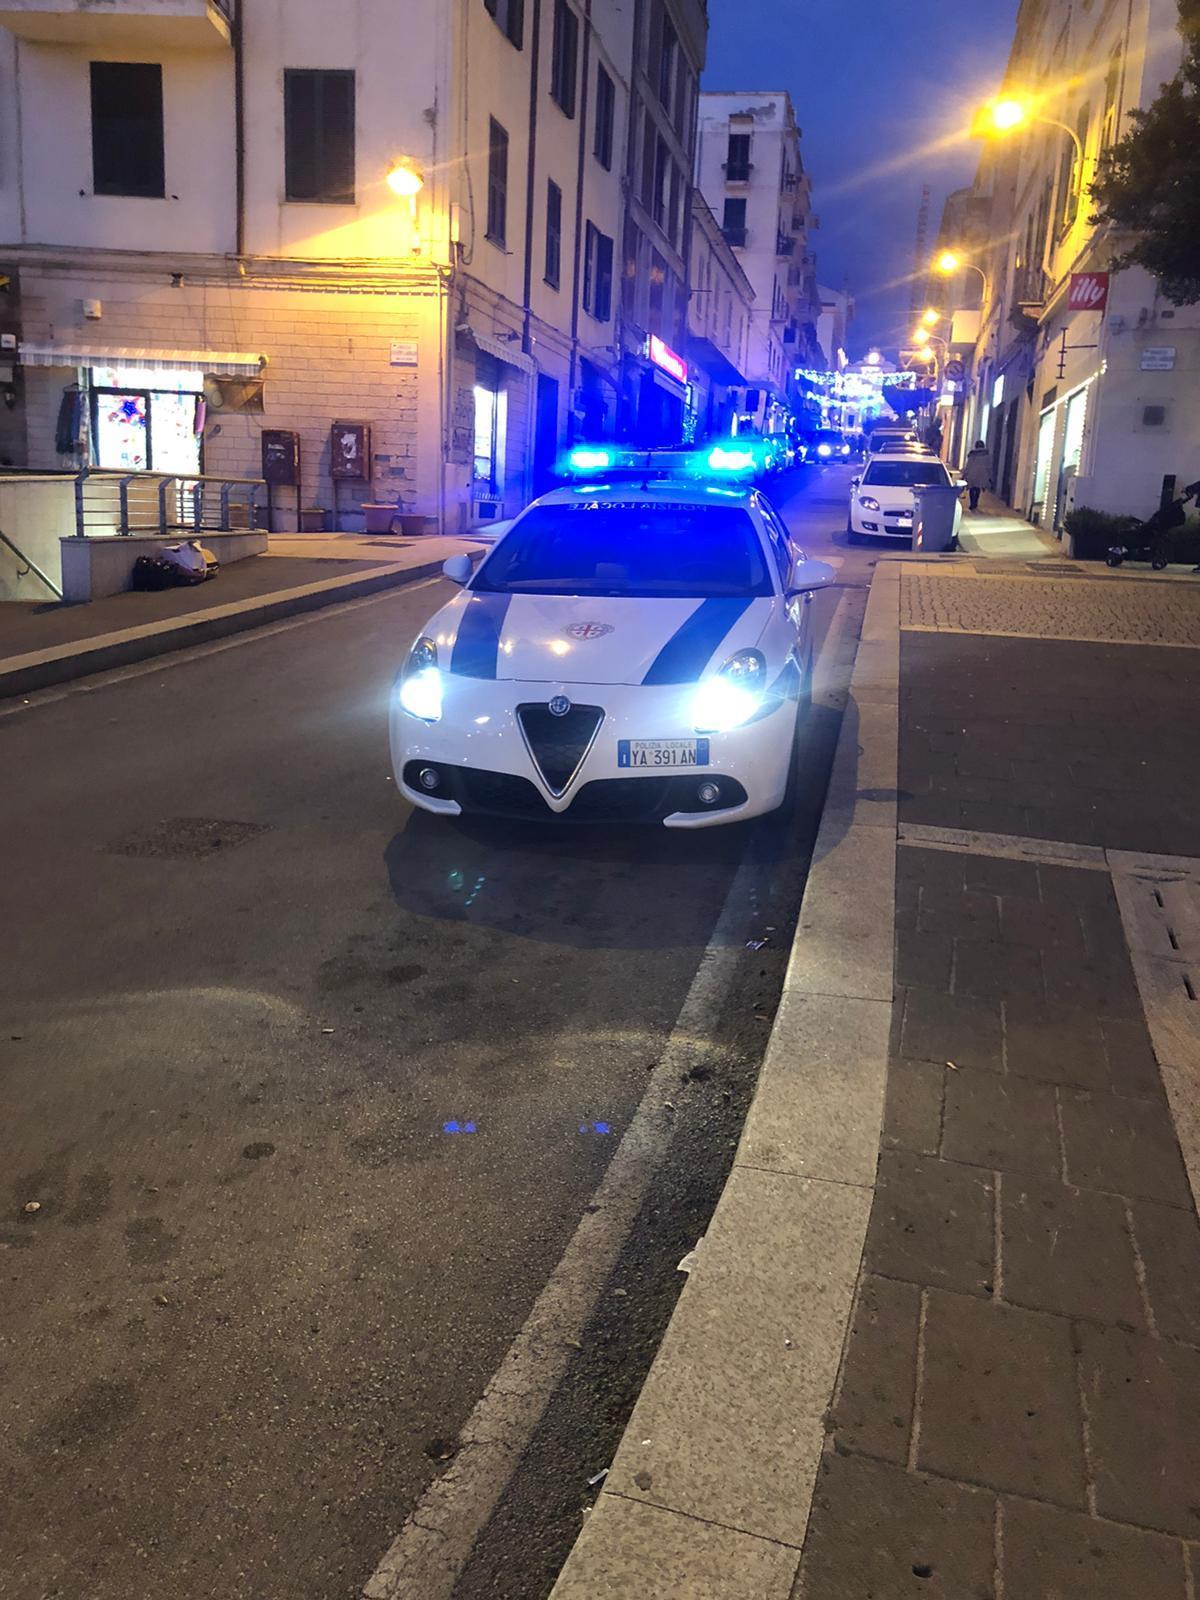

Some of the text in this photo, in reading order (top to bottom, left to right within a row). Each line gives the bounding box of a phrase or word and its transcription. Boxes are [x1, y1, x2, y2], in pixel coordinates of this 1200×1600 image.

[1071, 278, 1105, 307] illy
[635, 741, 694, 750] POLIZIA LOCALE
[632, 750, 648, 765] YA
[654, 749, 677, 765] 391
[680, 749, 696, 764] AN
